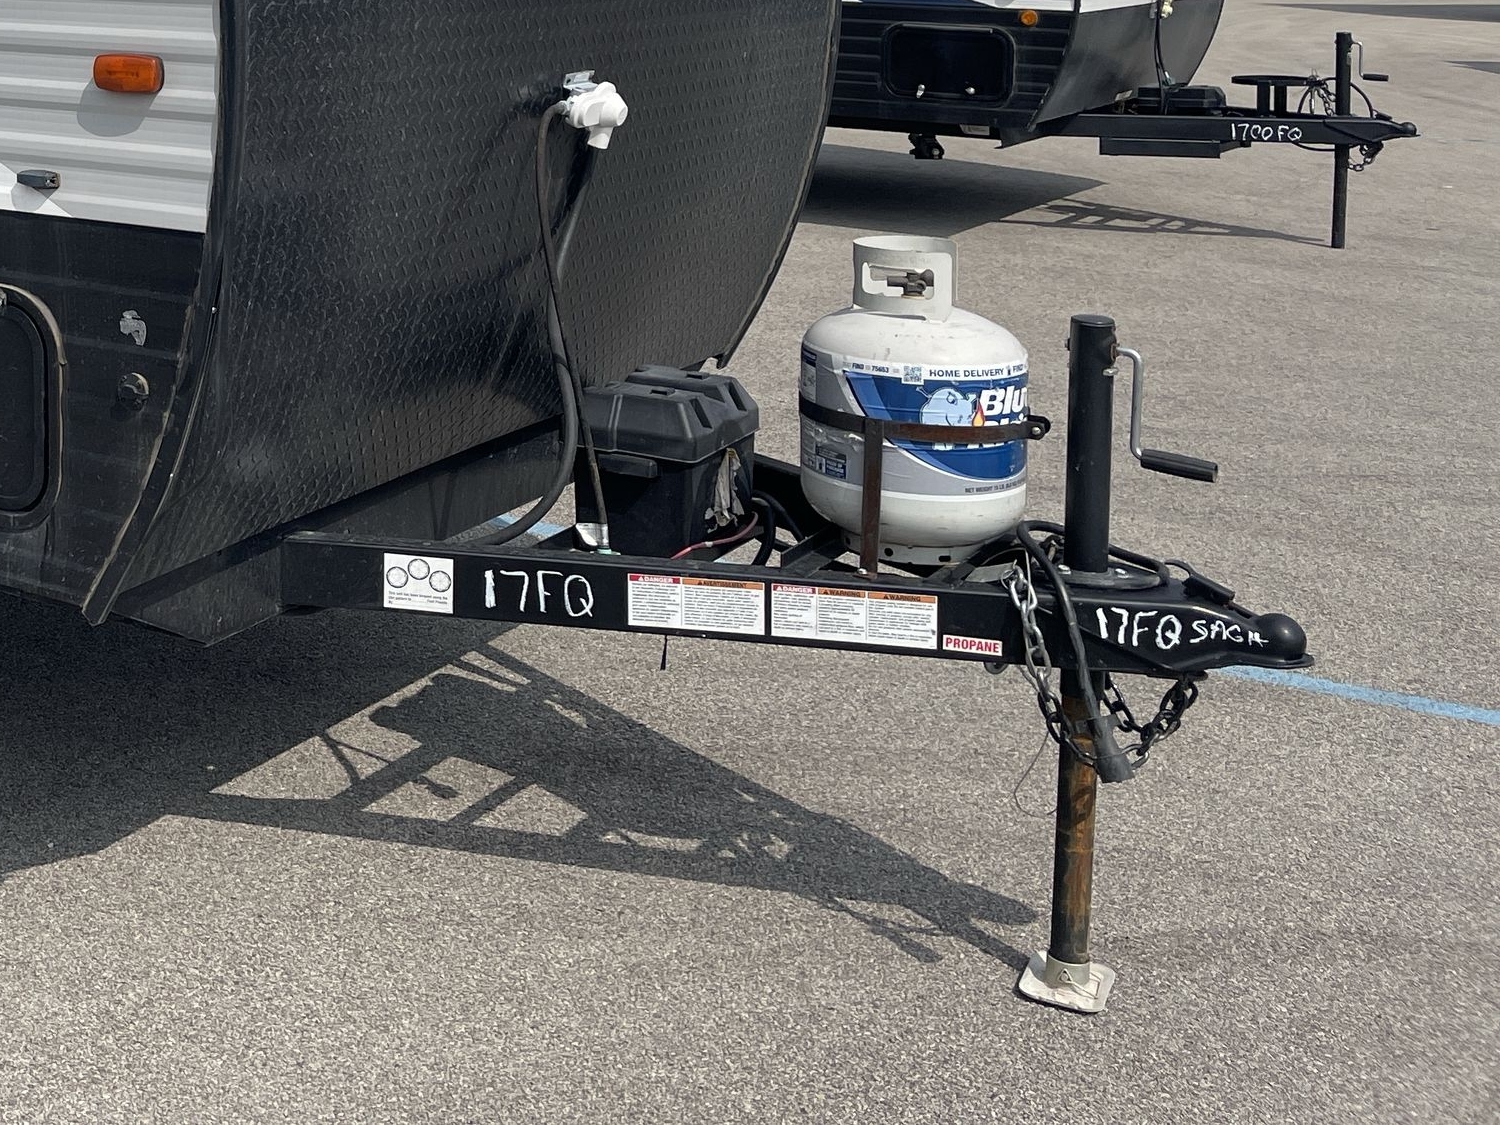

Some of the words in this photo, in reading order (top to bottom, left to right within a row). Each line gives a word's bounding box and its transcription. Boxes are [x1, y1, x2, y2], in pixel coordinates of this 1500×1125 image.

[929, 368, 961, 378] HOME
[963, 367, 1004, 378] DELIVERY
[643, 576, 675, 584] DANGER
[782, 585, 814, 594] DANGER
[829, 590, 861, 598] WARNING
[888, 594, 922, 603] WARNING
[1095, 607, 1183, 650] 17FQ
[944, 636, 1001, 654] PROPANE
